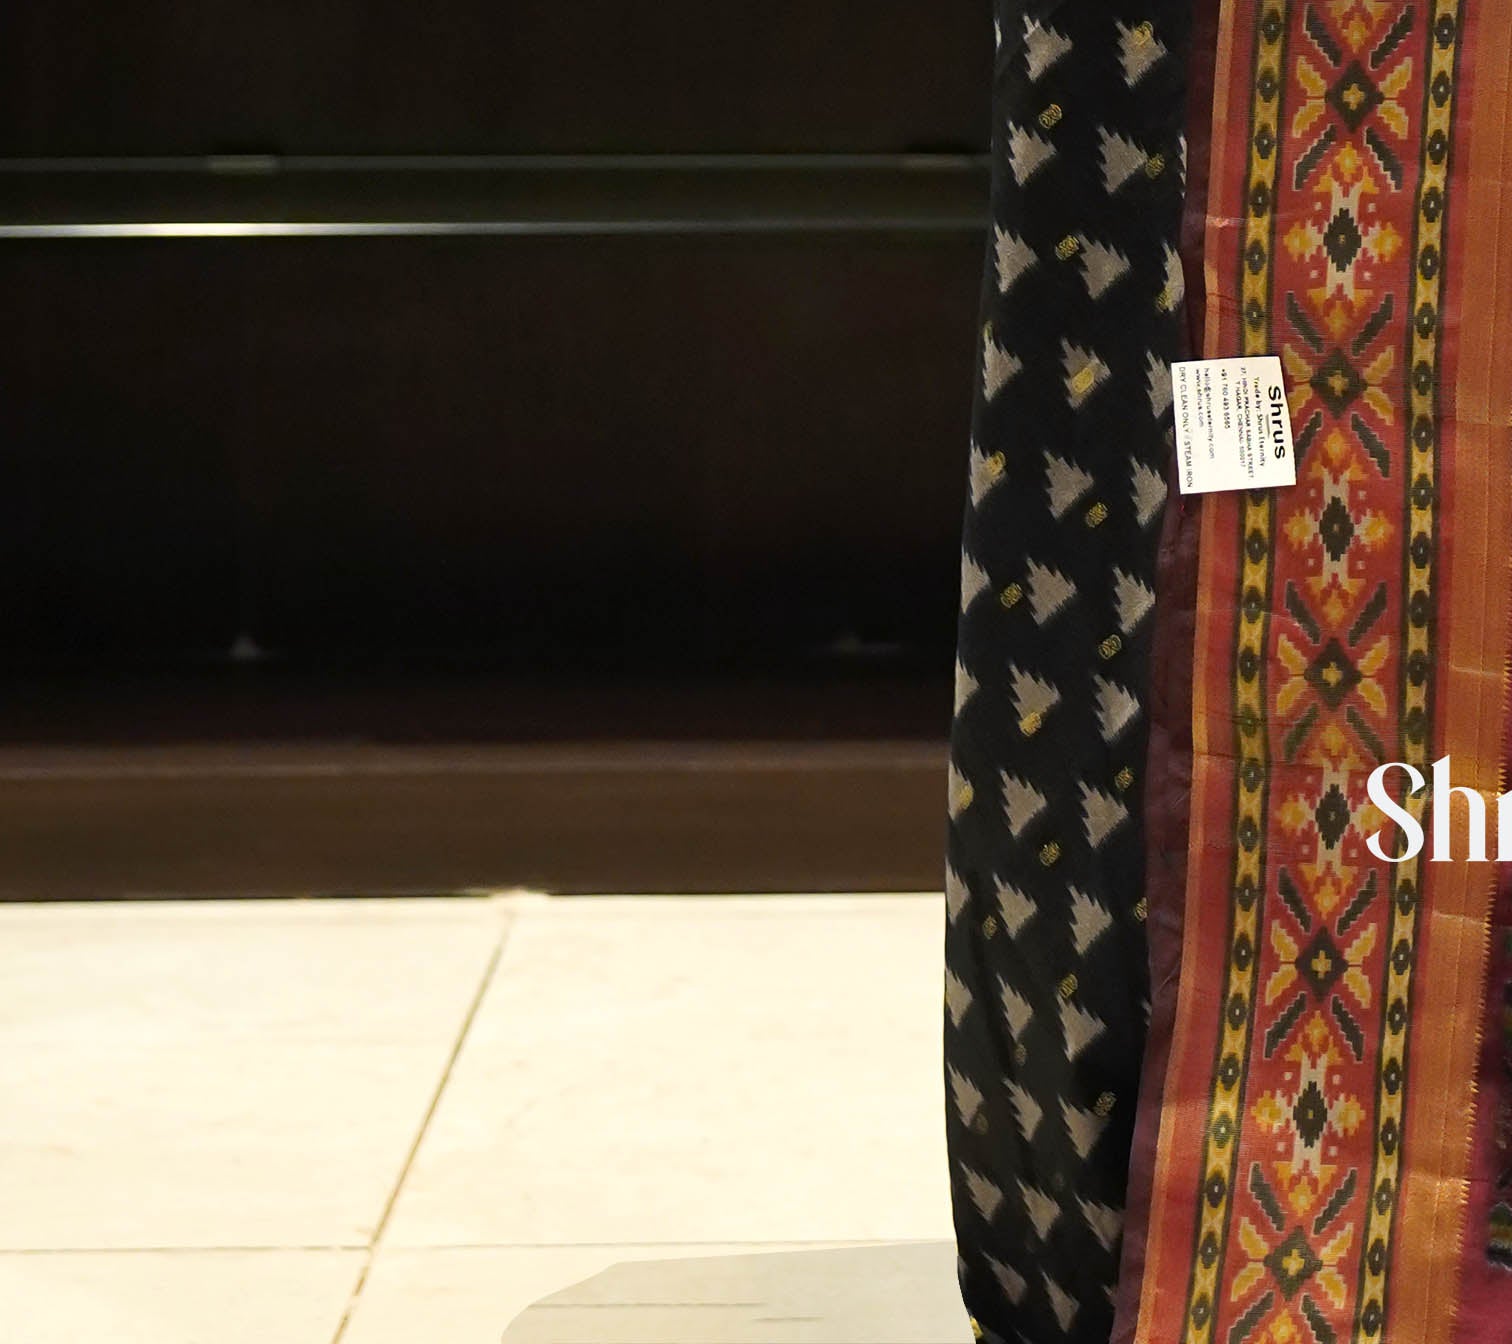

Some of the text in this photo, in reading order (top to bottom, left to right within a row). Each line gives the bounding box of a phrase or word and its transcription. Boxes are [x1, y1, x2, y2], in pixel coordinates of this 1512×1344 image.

[1180, 384, 1188, 410] CLEAN
[1182, 412, 1190, 433] ONLY
[1268, 386, 1285, 459] Shrus
[1184, 441, 1192, 466] STEAM
[1258, 436, 1266, 466] Eternity
